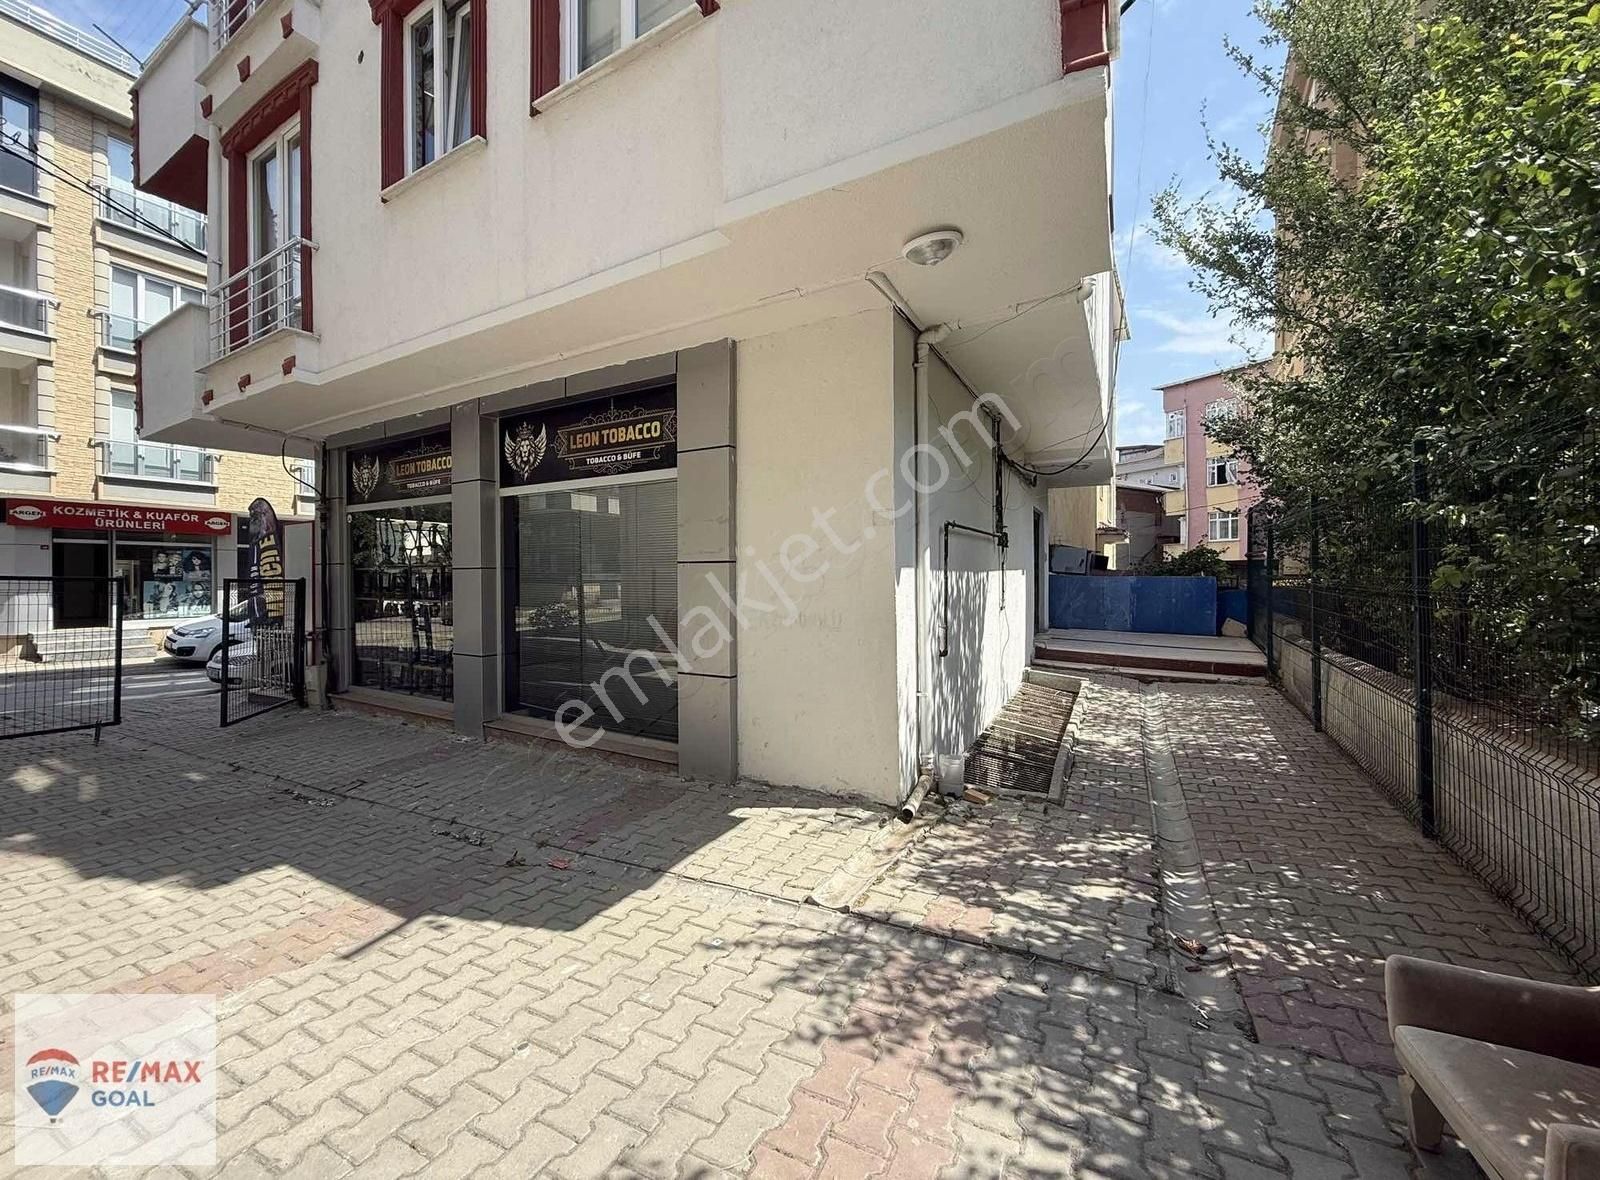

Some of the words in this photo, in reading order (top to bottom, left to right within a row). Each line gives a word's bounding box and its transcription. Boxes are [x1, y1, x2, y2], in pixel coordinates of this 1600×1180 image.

[569, 431, 600, 450] LEON
[601, 421, 661, 445] TOBACCO
[394, 462, 415, 477] LEON
[416, 456, 453, 473] TOBACCO
[586, 454, 616, 465] TOBACCO
[617, 453, 622, 461] &
[623, 451, 641, 461] BÜFE
[52, 505, 129, 519] KOZMETİK
[133, 510, 142, 519] &
[146, 511, 199, 522] KUAFÖR
[95, 517, 166, 530] ÜRÜNLERİ
